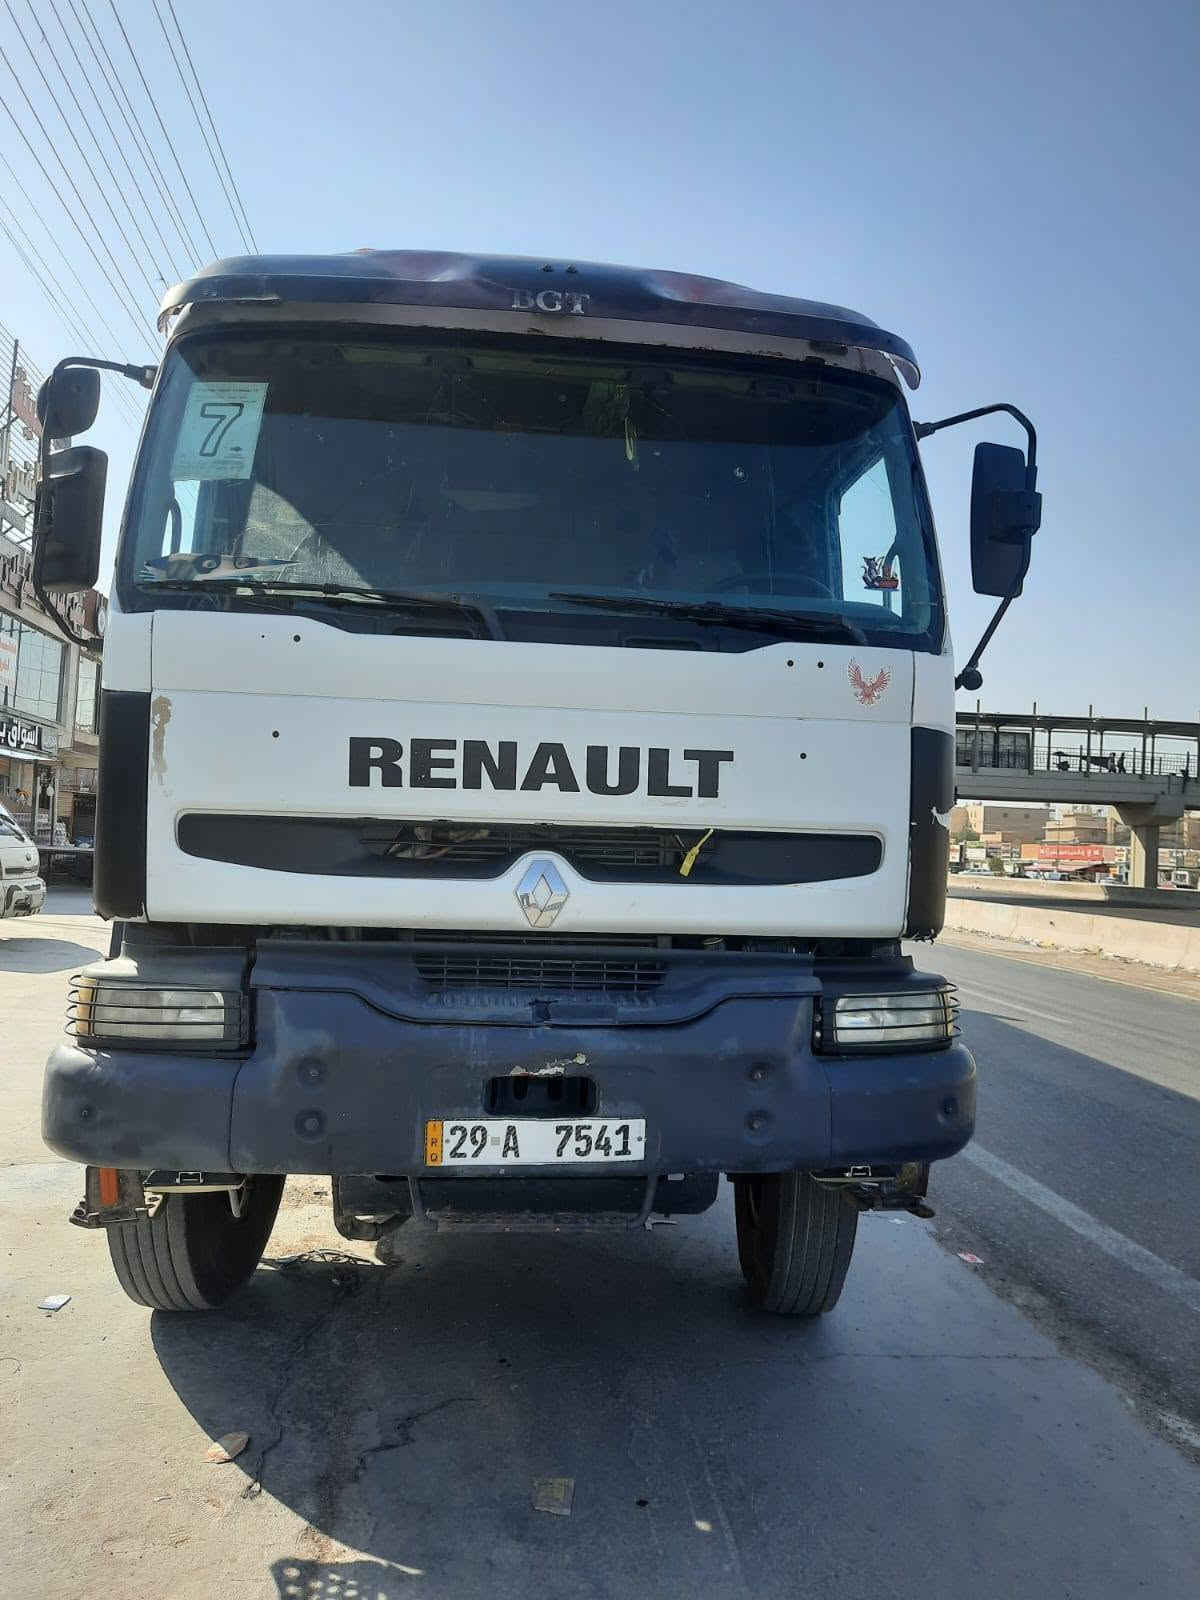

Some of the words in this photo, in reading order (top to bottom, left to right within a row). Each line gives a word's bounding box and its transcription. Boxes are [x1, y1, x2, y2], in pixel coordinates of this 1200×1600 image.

[510, 288, 590, 314] BGT
[199, 402, 244, 457] 7
[348, 736, 734, 799] RENAULT
[449, 1124, 488, 1159] 29
[502, 1124, 520, 1159] A
[555, 1123, 632, 1158] 7541
